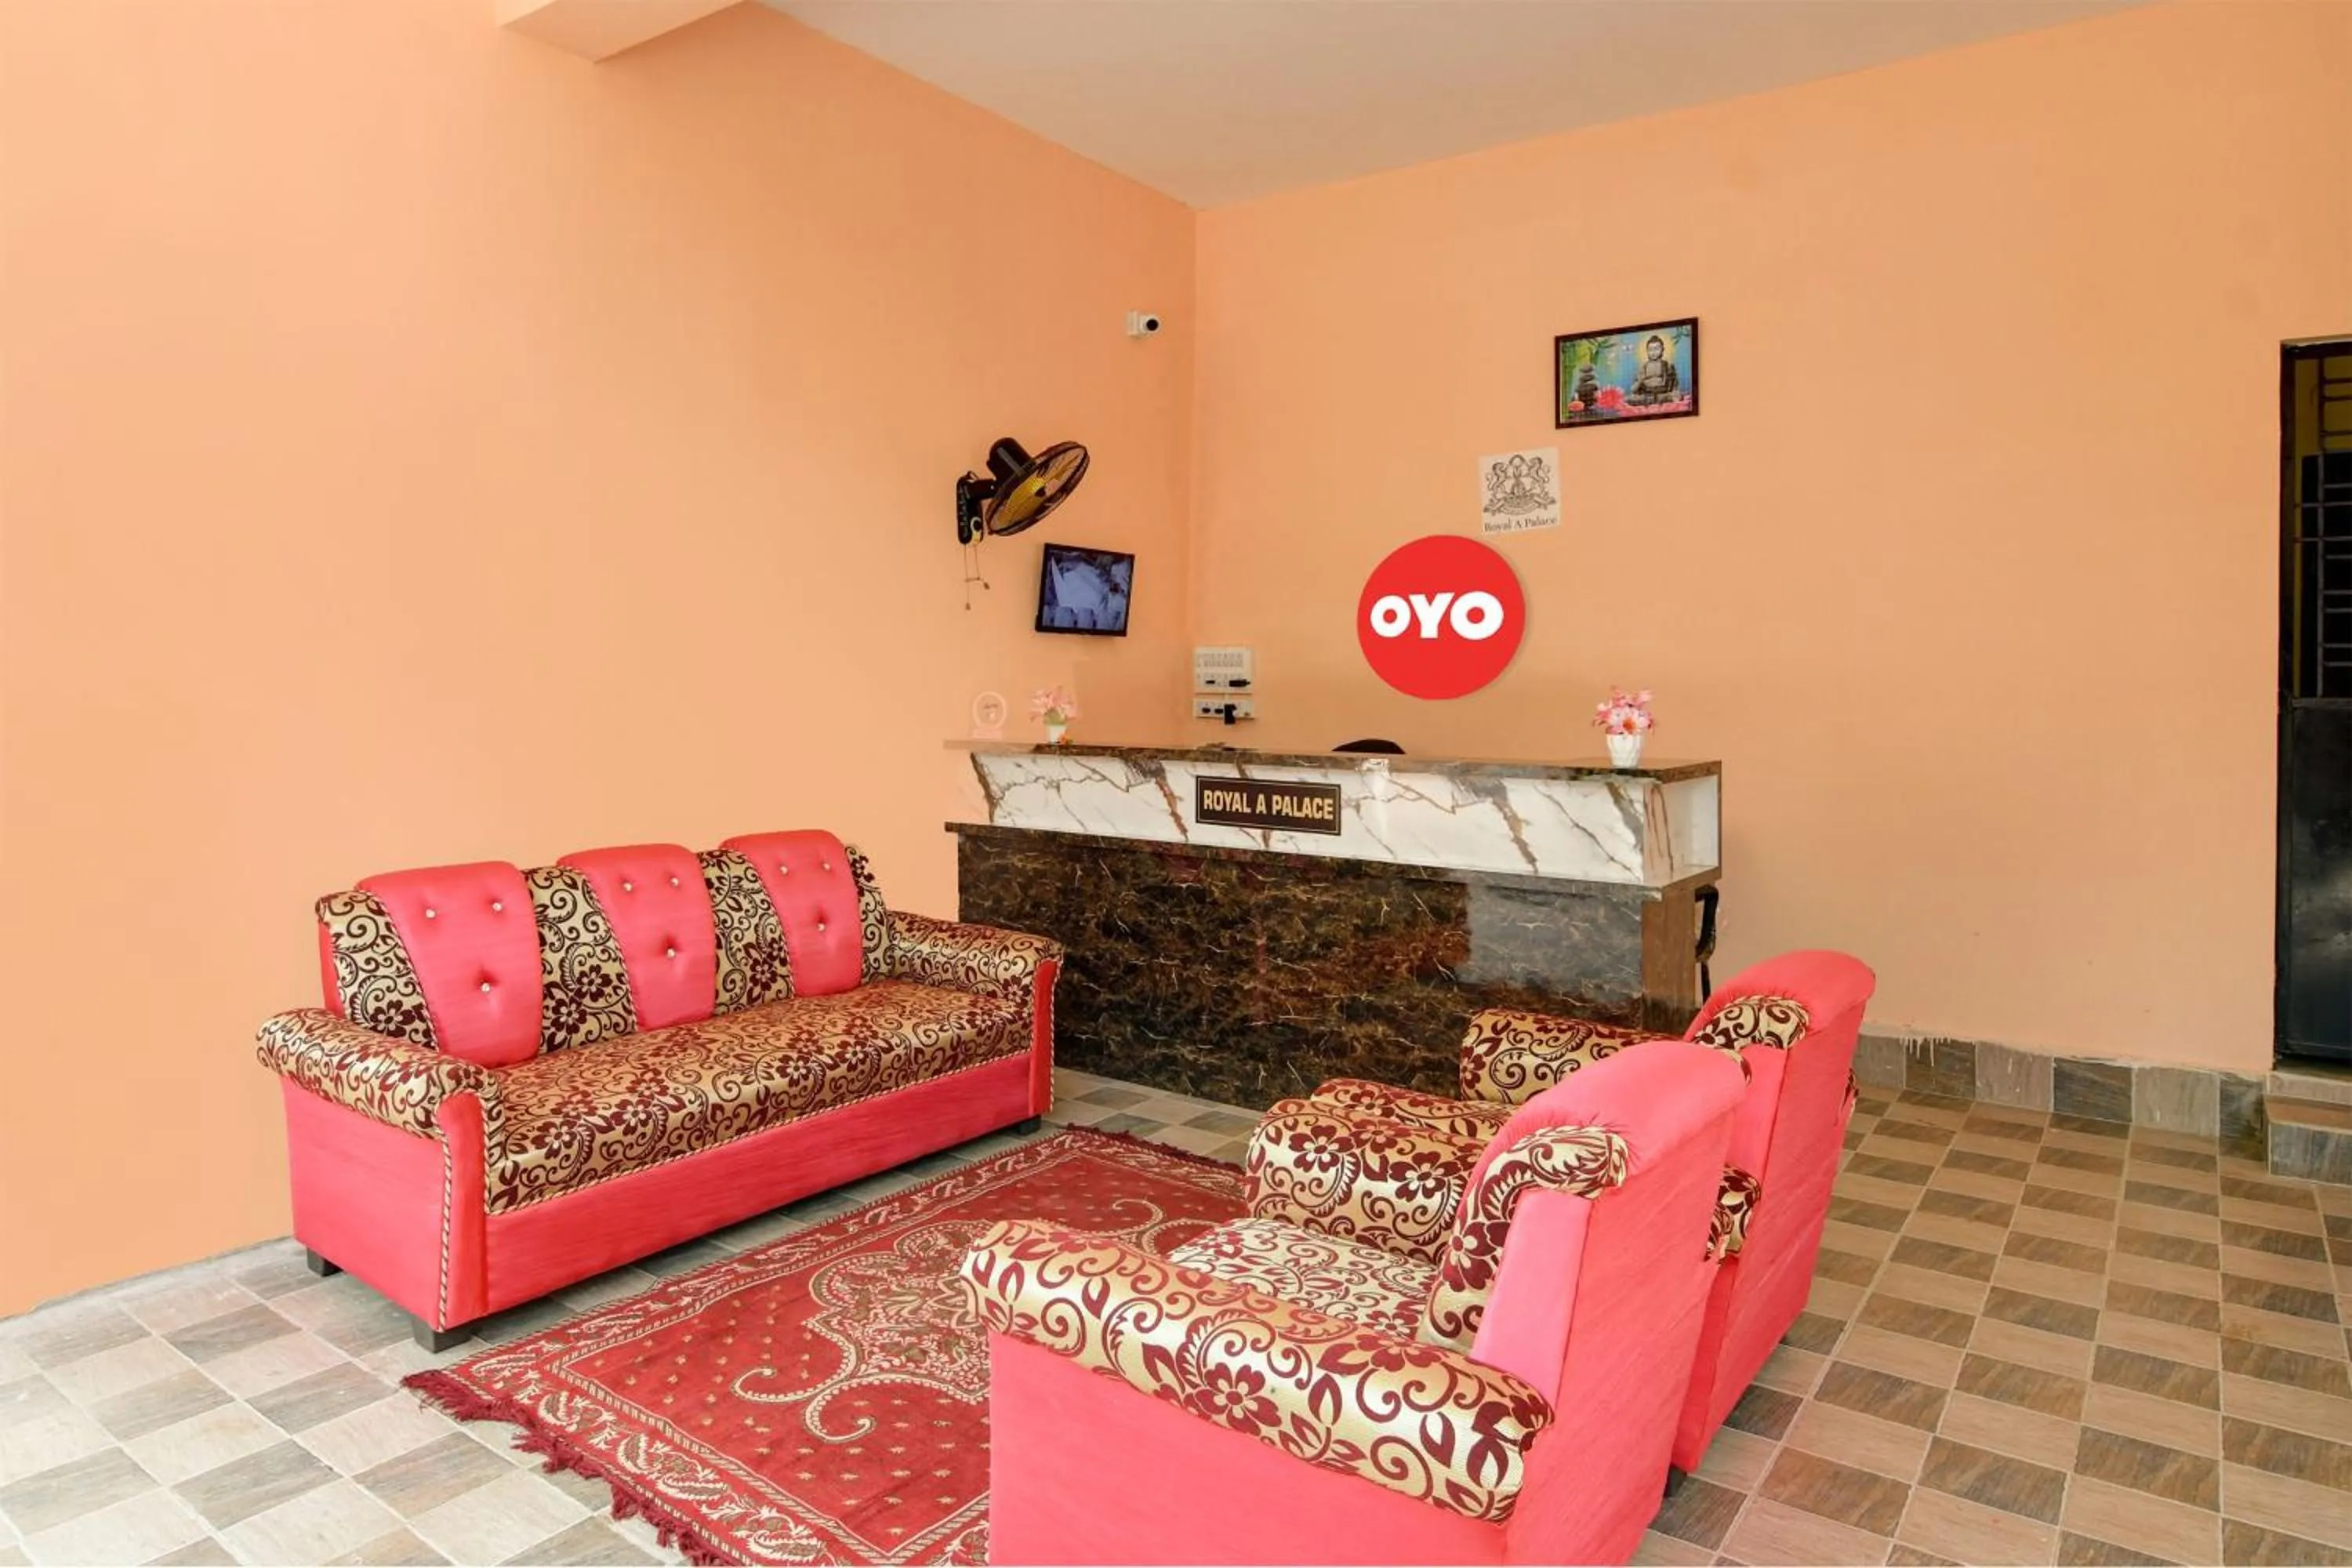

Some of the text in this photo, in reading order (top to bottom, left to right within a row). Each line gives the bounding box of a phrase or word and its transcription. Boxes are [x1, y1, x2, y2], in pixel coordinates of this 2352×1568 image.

[1484, 516, 1558, 532] Royal A Palace
[1370, 590, 1504, 641] OYO
[1203, 789, 1334, 820] ROYAL A PALACE
